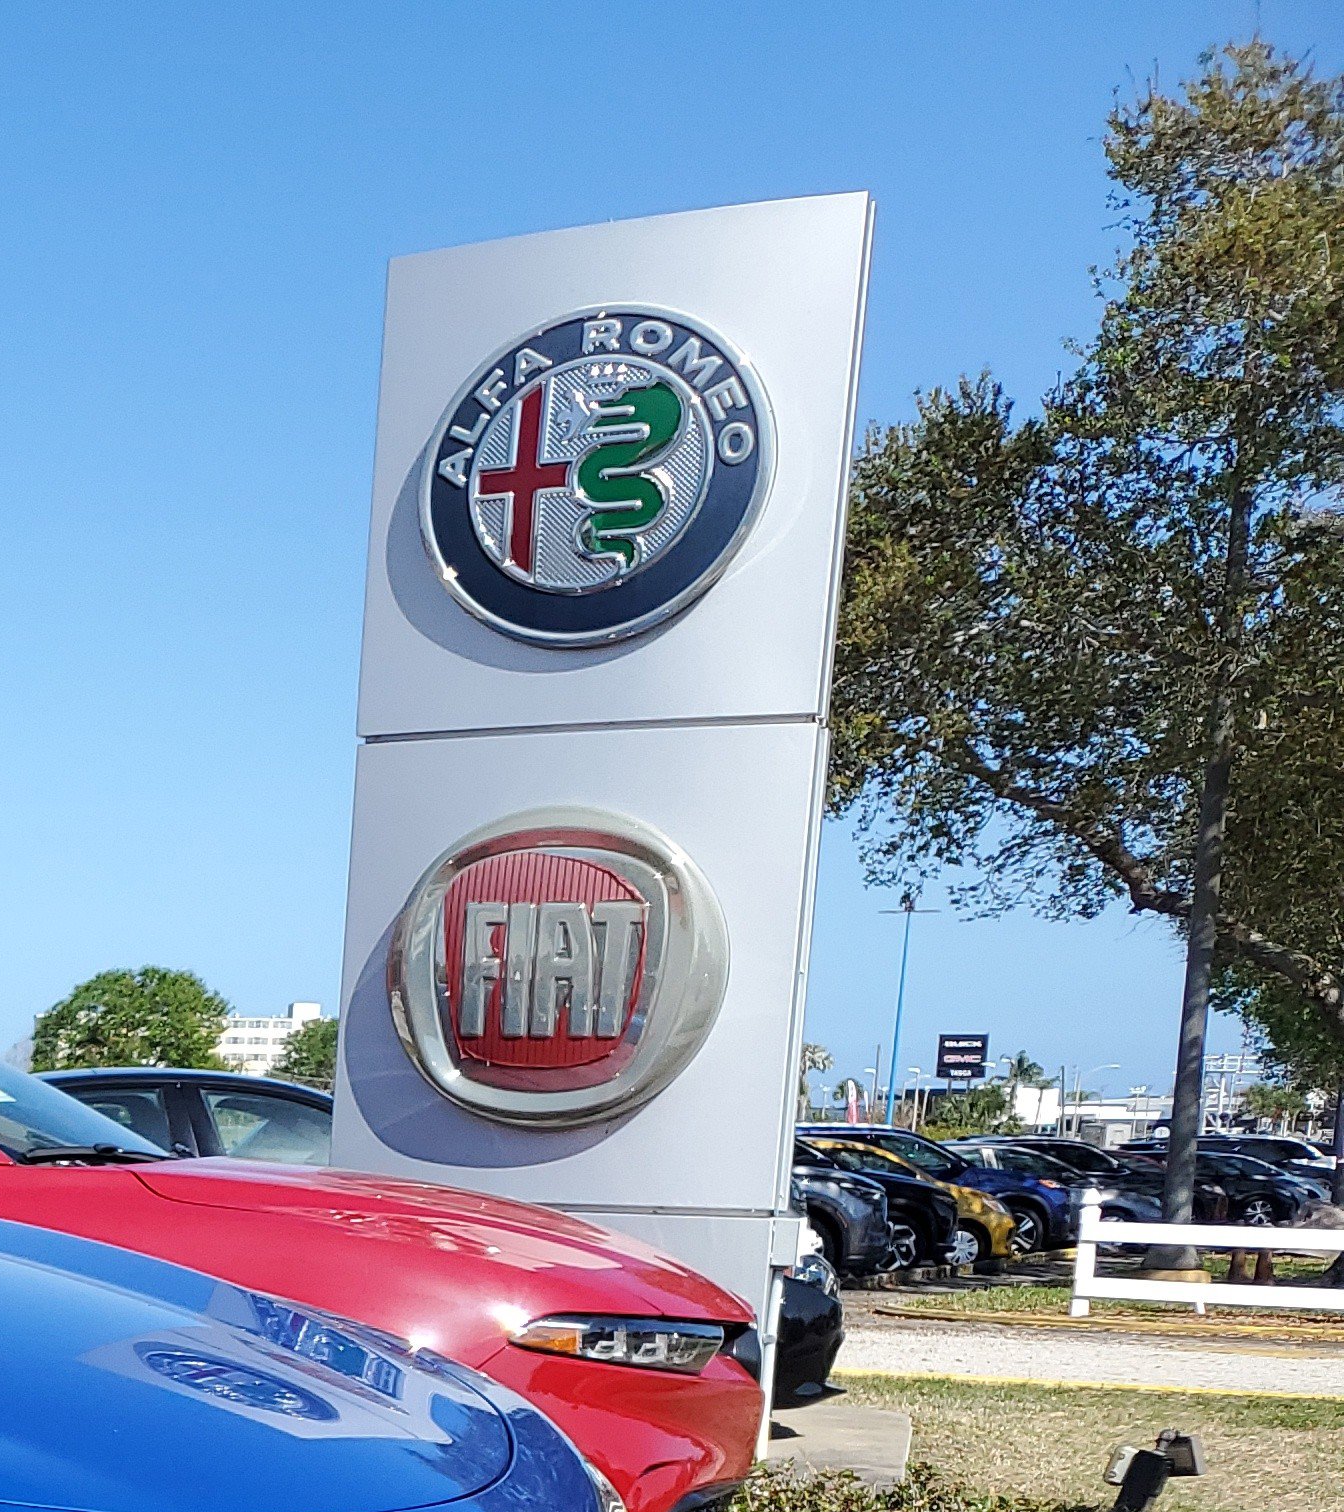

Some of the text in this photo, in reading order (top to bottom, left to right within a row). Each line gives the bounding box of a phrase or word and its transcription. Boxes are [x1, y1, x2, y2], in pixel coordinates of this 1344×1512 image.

[438, 318, 755, 488] ALFA ROMEO
[459, 900, 650, 1039] FIAT
